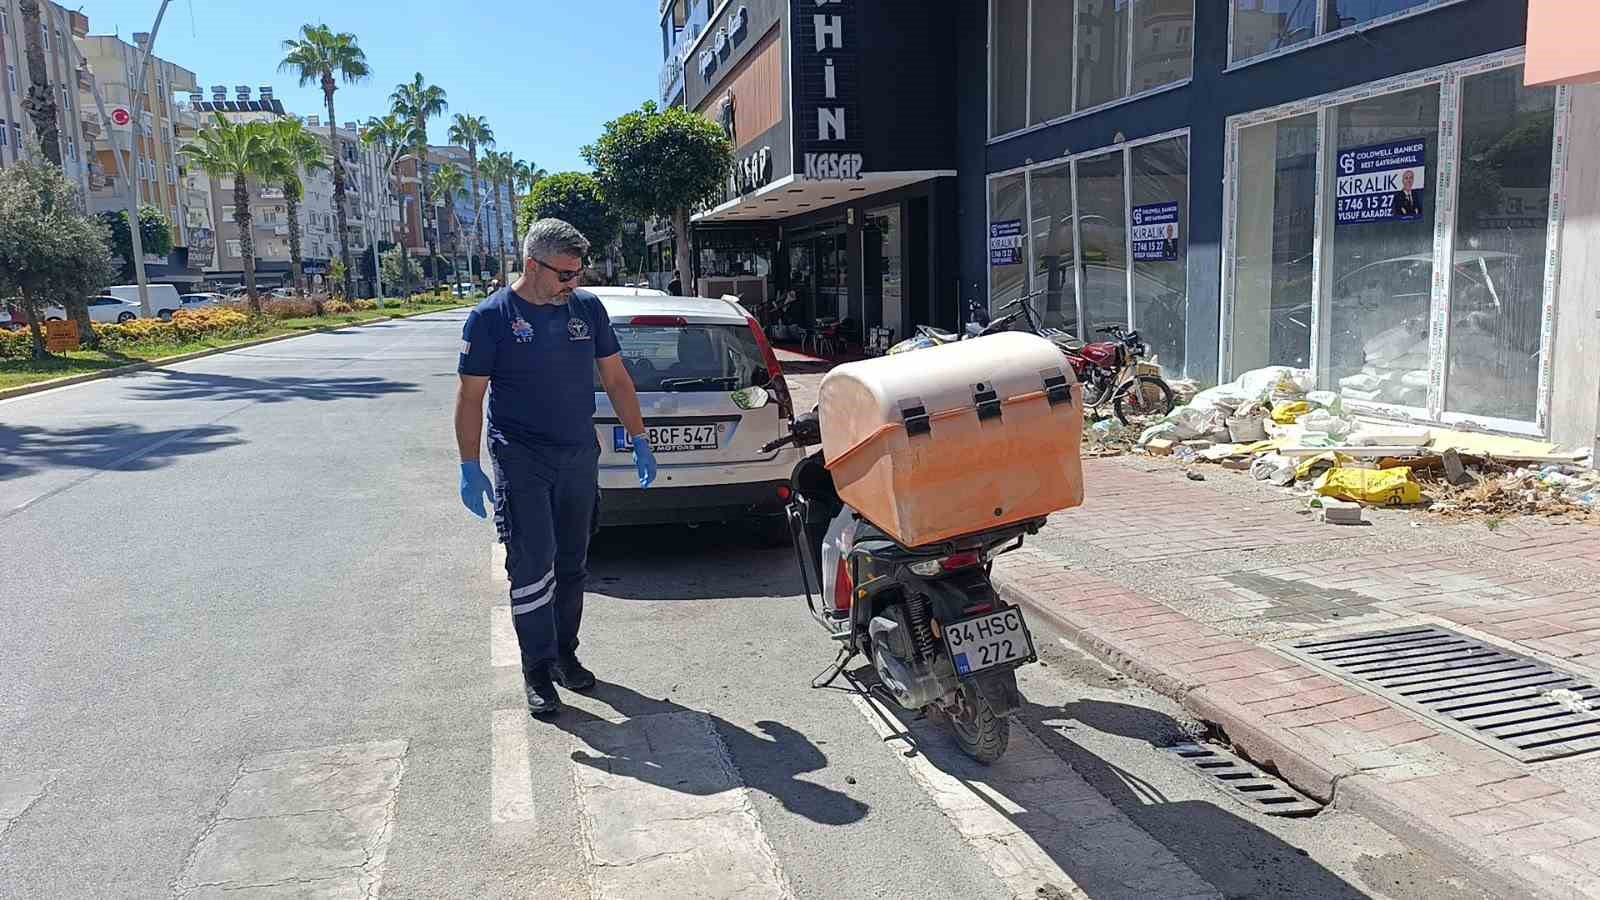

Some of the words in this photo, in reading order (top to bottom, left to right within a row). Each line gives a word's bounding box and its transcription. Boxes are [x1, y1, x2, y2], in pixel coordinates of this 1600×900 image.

[814, 0, 845, 140] HİN
[1356, 148, 1393, 160] COLDWELL
[1394, 144, 1424, 155] BANKER
[804, 153, 862, 180] KASAP
[1339, 174, 1398, 195] KİRALIK
[1345, 198, 1363, 211] 746
[1367, 197, 1378, 208] 15
[1381, 195, 1394, 207] 27
[649, 428, 680, 444] BCF
[683, 427, 713, 443] 547
[949, 624, 975, 646] 34
[976, 613, 1019, 640] HSC
[978, 640, 1016, 665] 272
